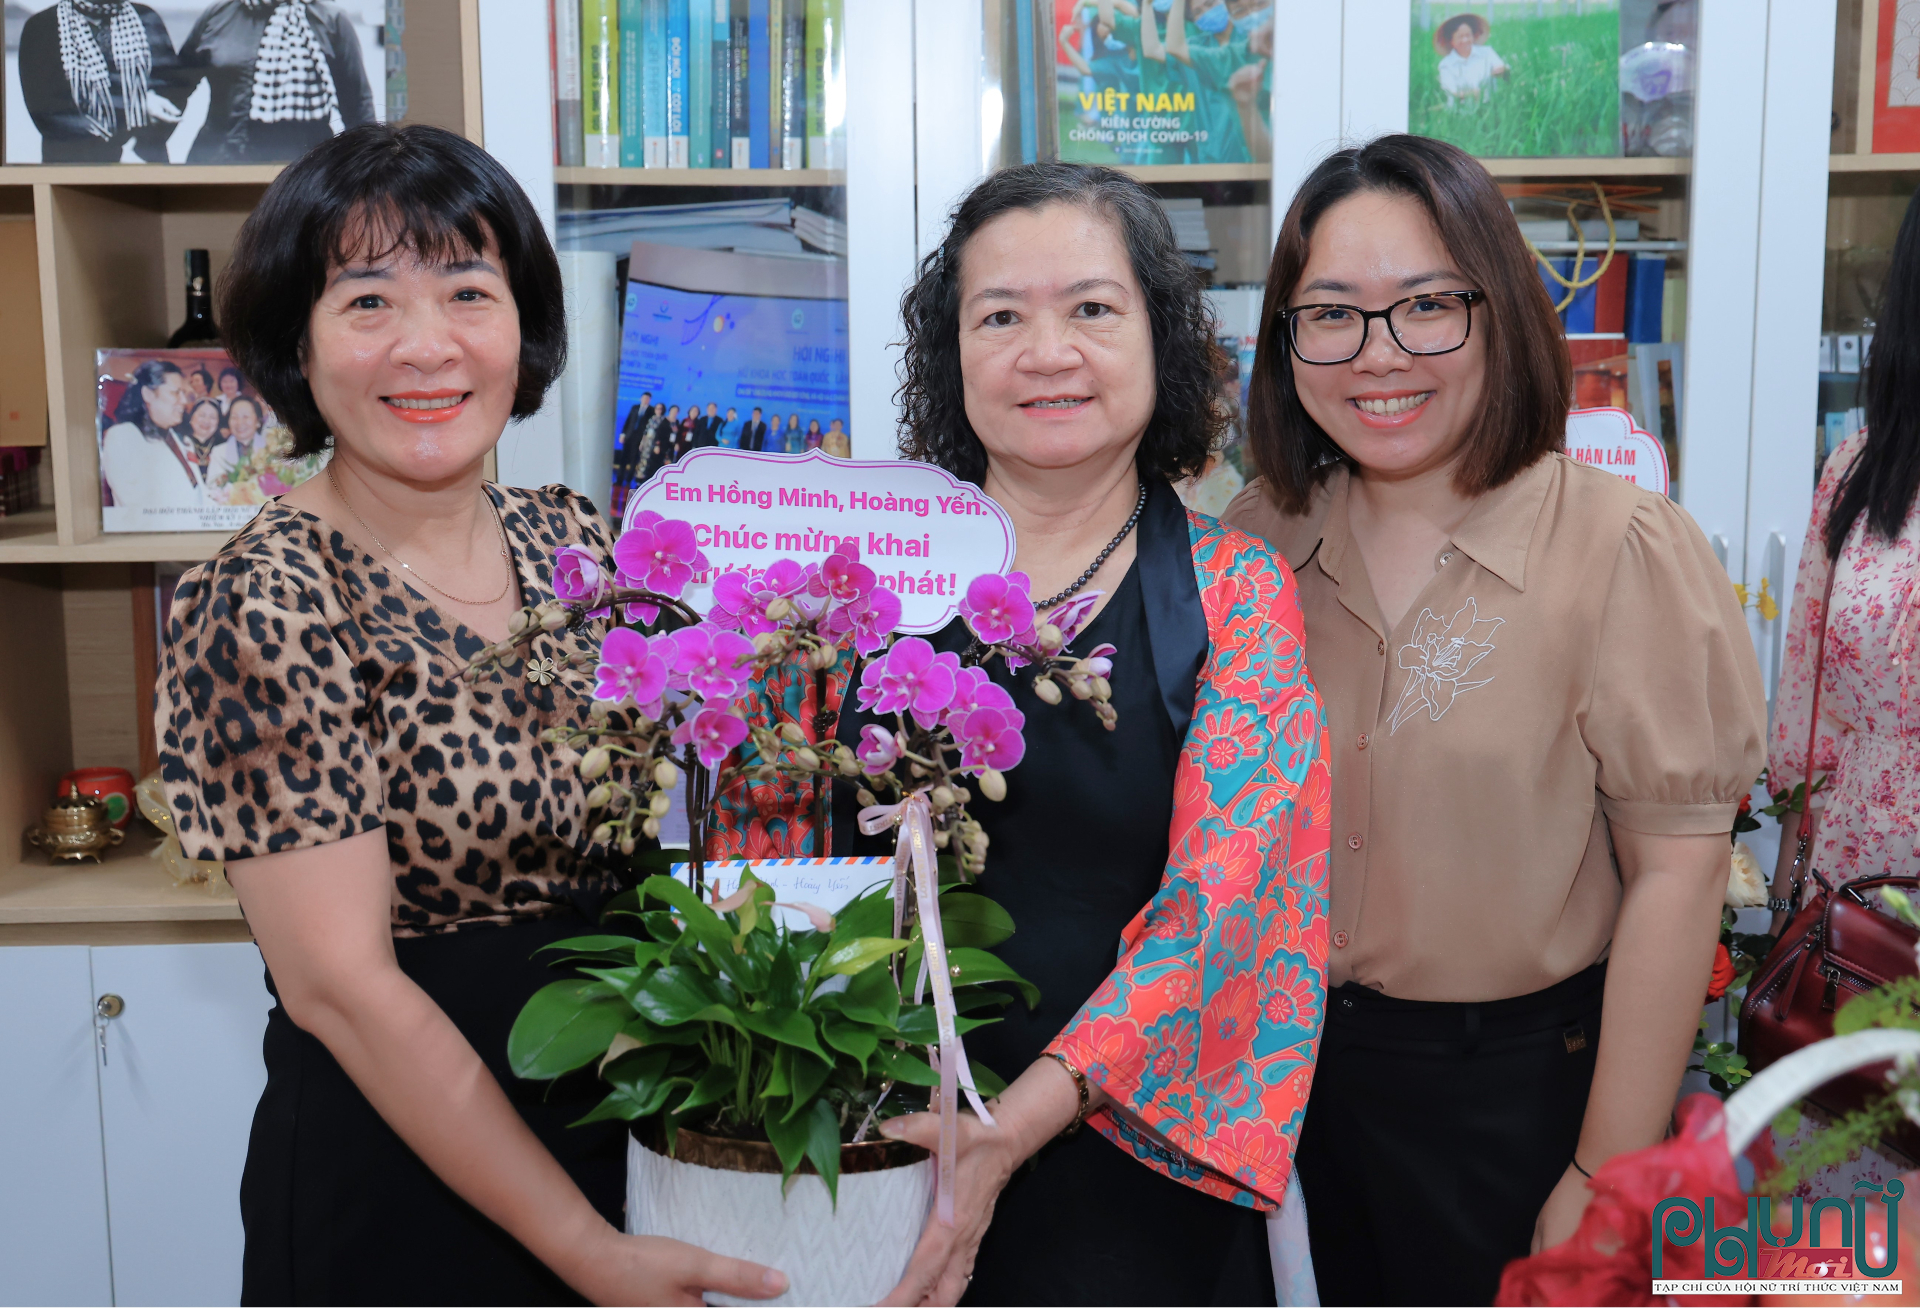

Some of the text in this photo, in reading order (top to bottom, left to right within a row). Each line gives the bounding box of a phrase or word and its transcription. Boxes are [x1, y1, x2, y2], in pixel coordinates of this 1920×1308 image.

[1078, 87, 1195, 116] VIỆT NAM
[1101, 115, 1129, 129] KIÊN
[1117, 130, 1148, 145] DỊCH
[1150, 130, 1209, 143] COVID-19
[1576, 444, 1603, 465] HÀN
[1607, 445, 1636, 466] LÂM
[664, 479, 989, 517] Em Hồng Minh, Hoàng Yến.
[695, 522, 768, 550] Chúc
[868, 532, 930, 558] khai
